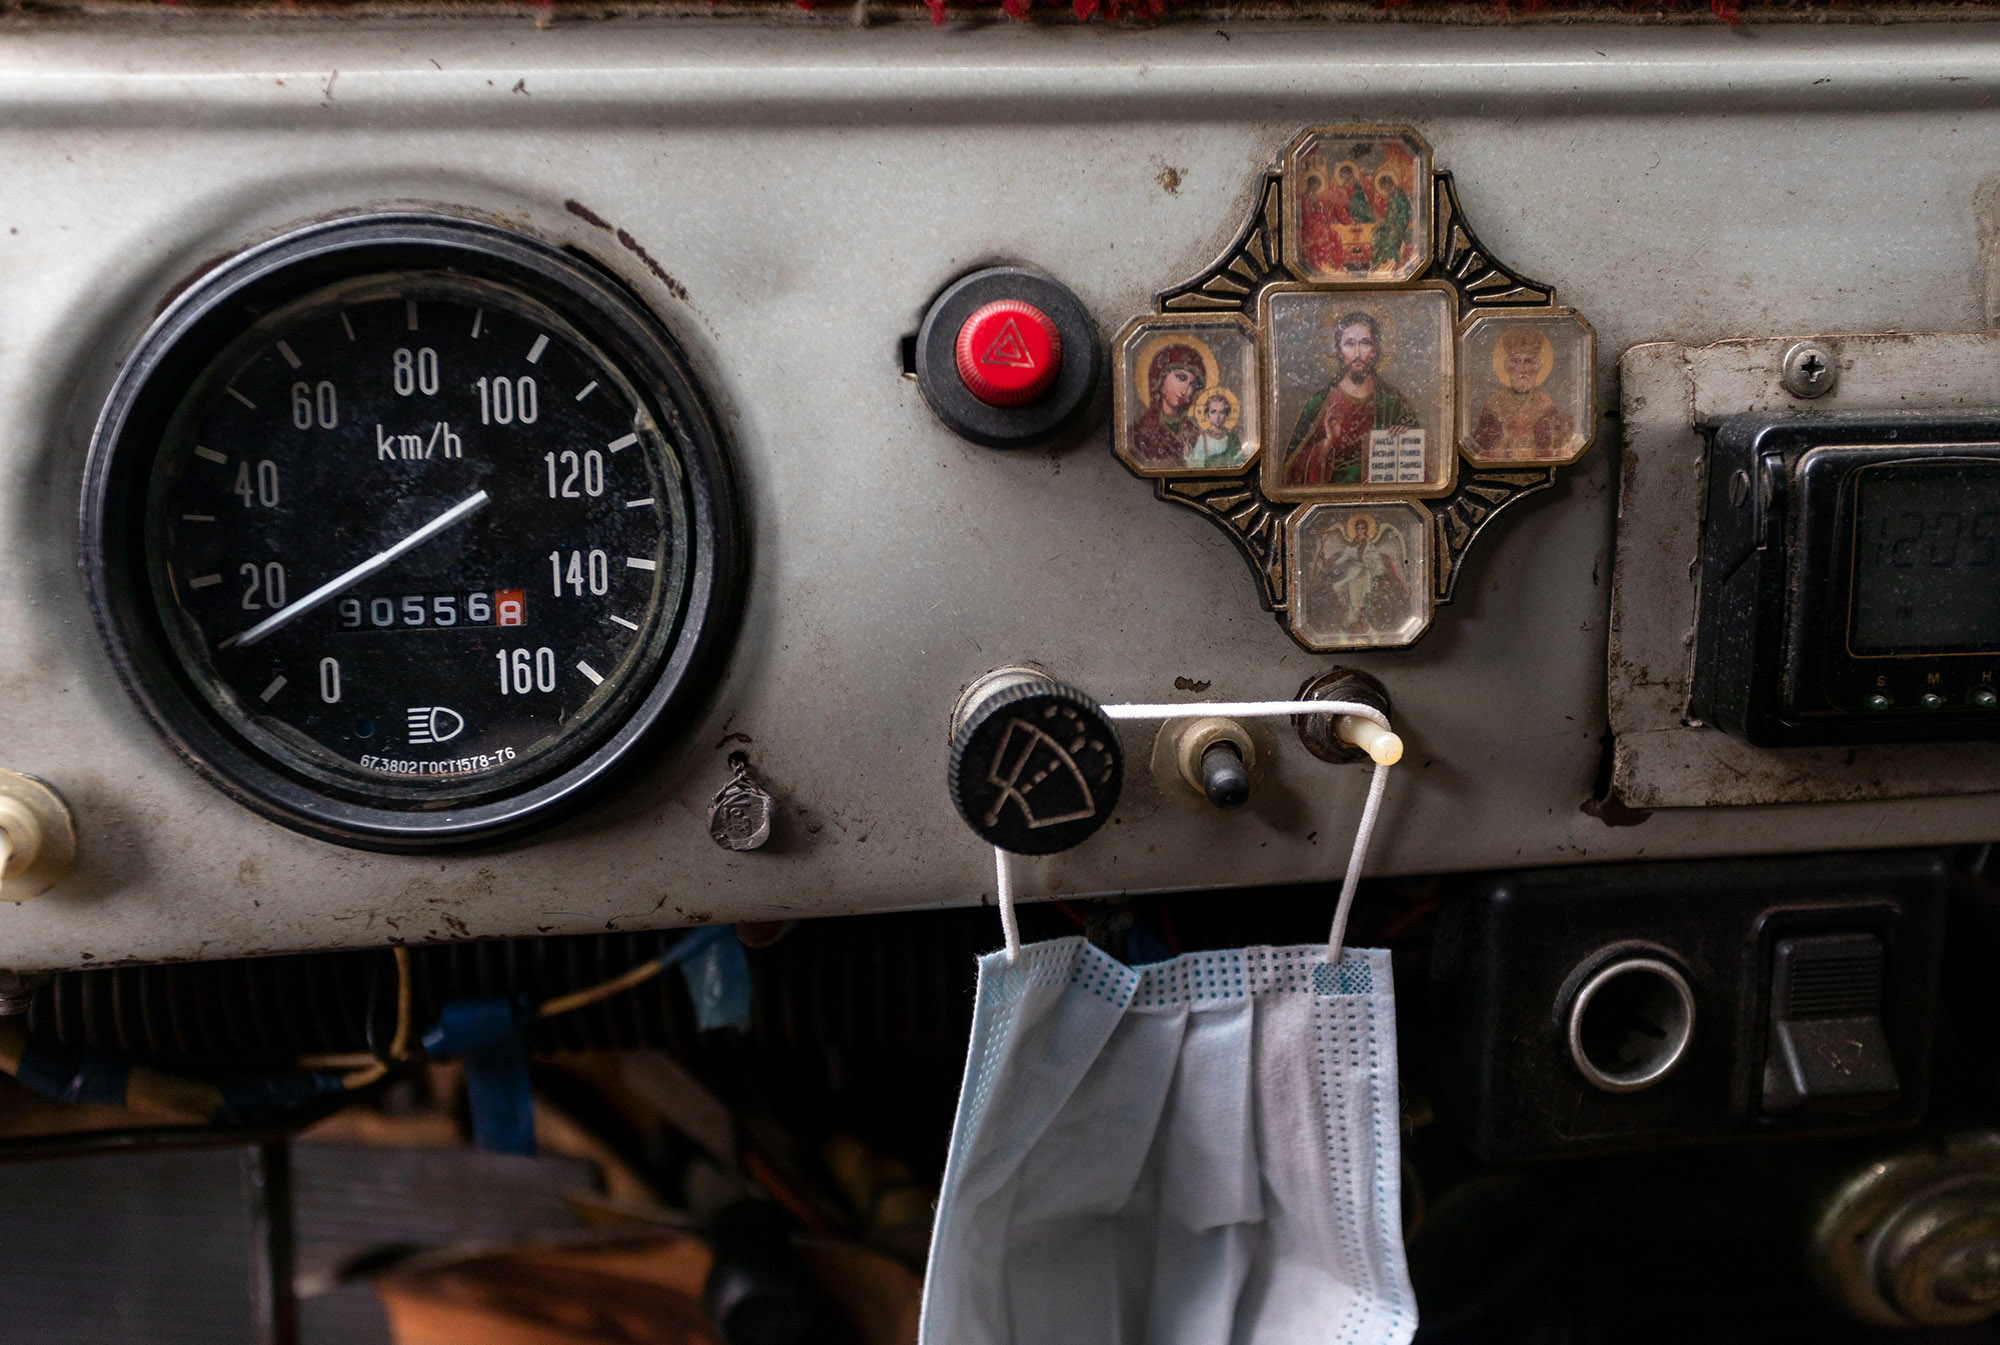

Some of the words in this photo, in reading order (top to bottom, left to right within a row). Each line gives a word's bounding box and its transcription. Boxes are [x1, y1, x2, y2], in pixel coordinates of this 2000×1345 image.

[394, 348, 439, 397] 80
[293, 381, 339, 430] 60
[477, 376, 538, 425] 100
[377, 422, 463, 461] km/h
[235, 460, 280, 508] 40
[544, 450, 604, 499] 120
[240, 562, 286, 610] 20
[549, 549, 609, 598] 140
[320, 657, 341, 704] 0
[496, 647, 556, 696] 160
[1876, 675, 1887, 687] S
[1928, 672, 1940, 684] M
[1982, 671, 1992, 682] H
